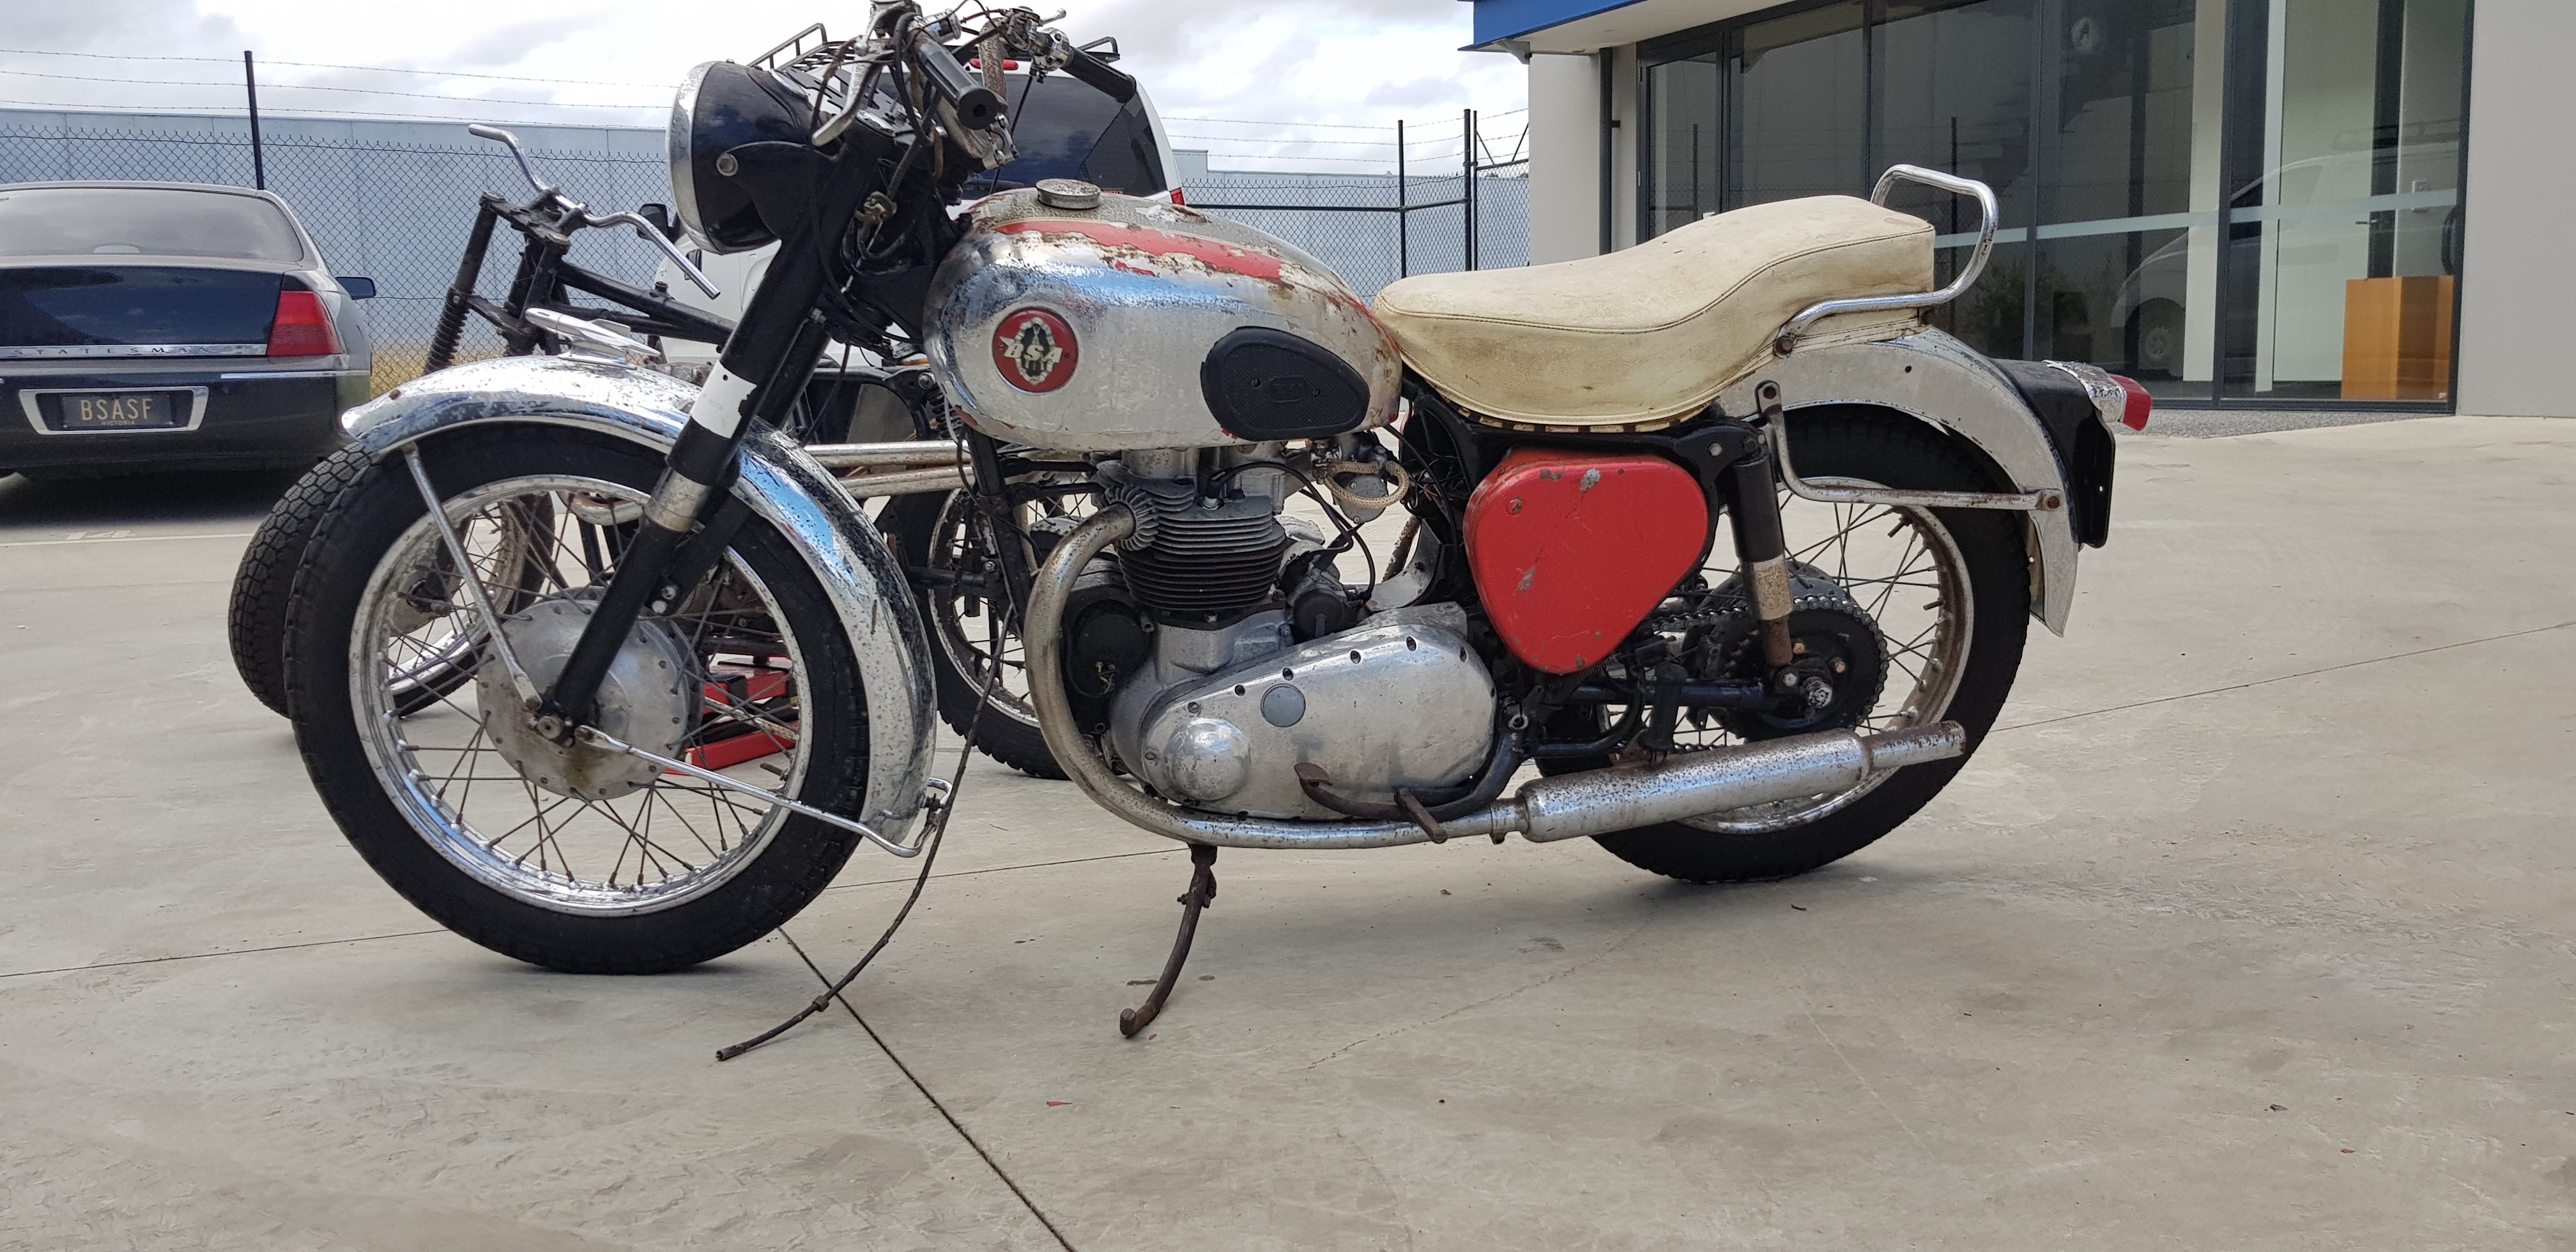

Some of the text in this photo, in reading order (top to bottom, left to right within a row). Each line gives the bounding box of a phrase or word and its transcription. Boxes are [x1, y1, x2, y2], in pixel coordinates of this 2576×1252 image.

[14, 347, 209, 355] STATESMAN
[999, 336, 1062, 363] BSA
[80, 398, 152, 421] BSASF
